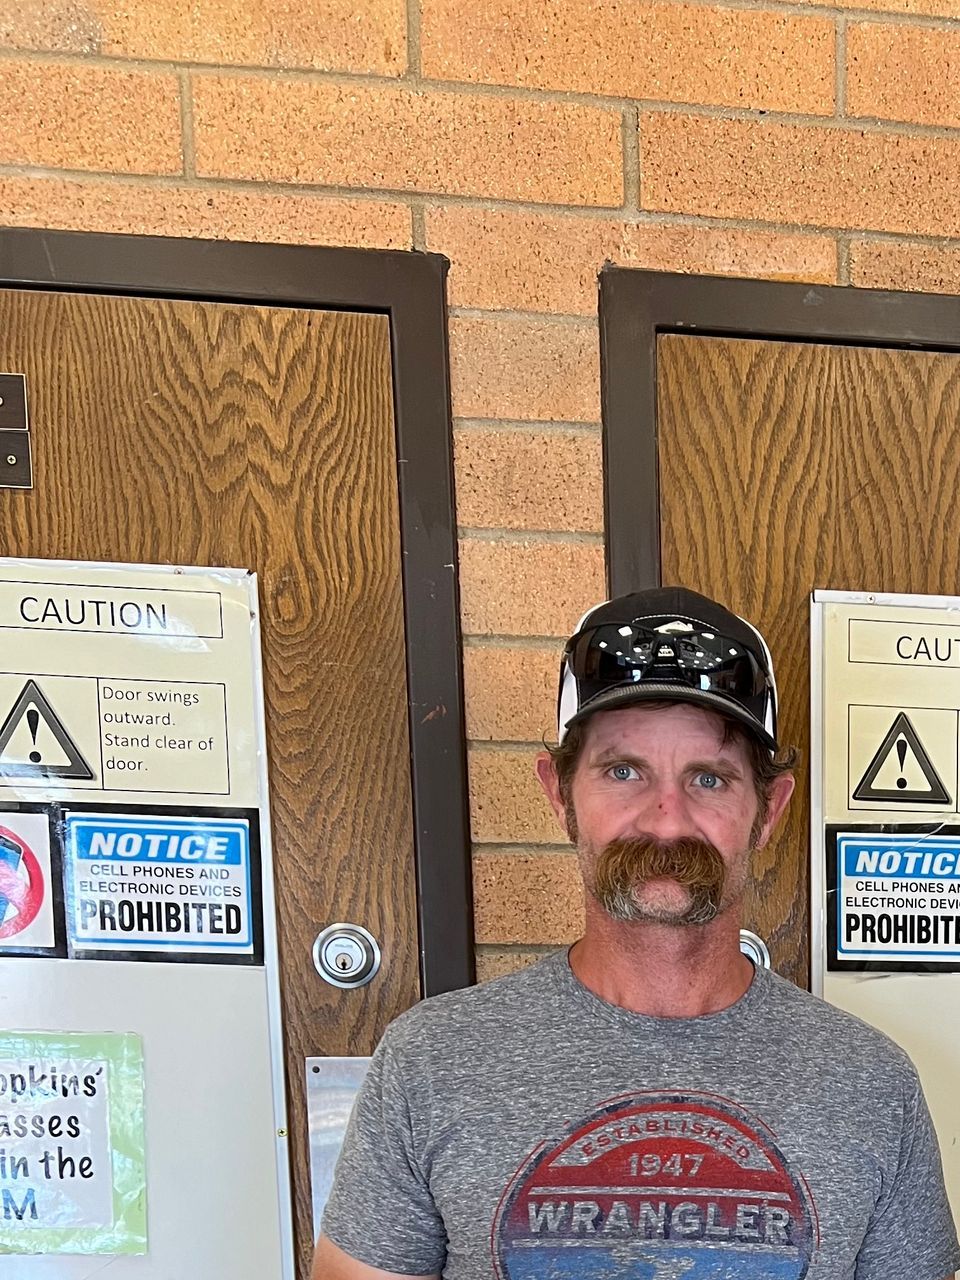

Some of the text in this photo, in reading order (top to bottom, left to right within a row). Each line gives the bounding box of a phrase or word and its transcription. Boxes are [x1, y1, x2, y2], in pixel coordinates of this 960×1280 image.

[19, 596, 168, 630] CAUTION
[103, 686, 200, 707] Door swings
[103, 711, 176, 728] outward.
[104, 733, 215, 752] Stand clear of
[105, 756, 149, 772] door.
[88, 831, 230, 862] NOTICE
[90, 864, 230, 880] CELL PHONES AND
[79, 880, 242, 898] ELECTRONIC DEVICES
[855, 880, 889, 893] CELL
[891, 880, 945, 895] PHONES
[845, 896, 927, 910] ELECTRONIC
[80, 899, 242, 935] PROHIBITED
[581, 1119, 750, 1160] ESTABLISHED
[0, 1146, 94, 1180] in the
[627, 1152, 705, 1178] 1947
[527, 1199, 793, 1243] WRANGLER
